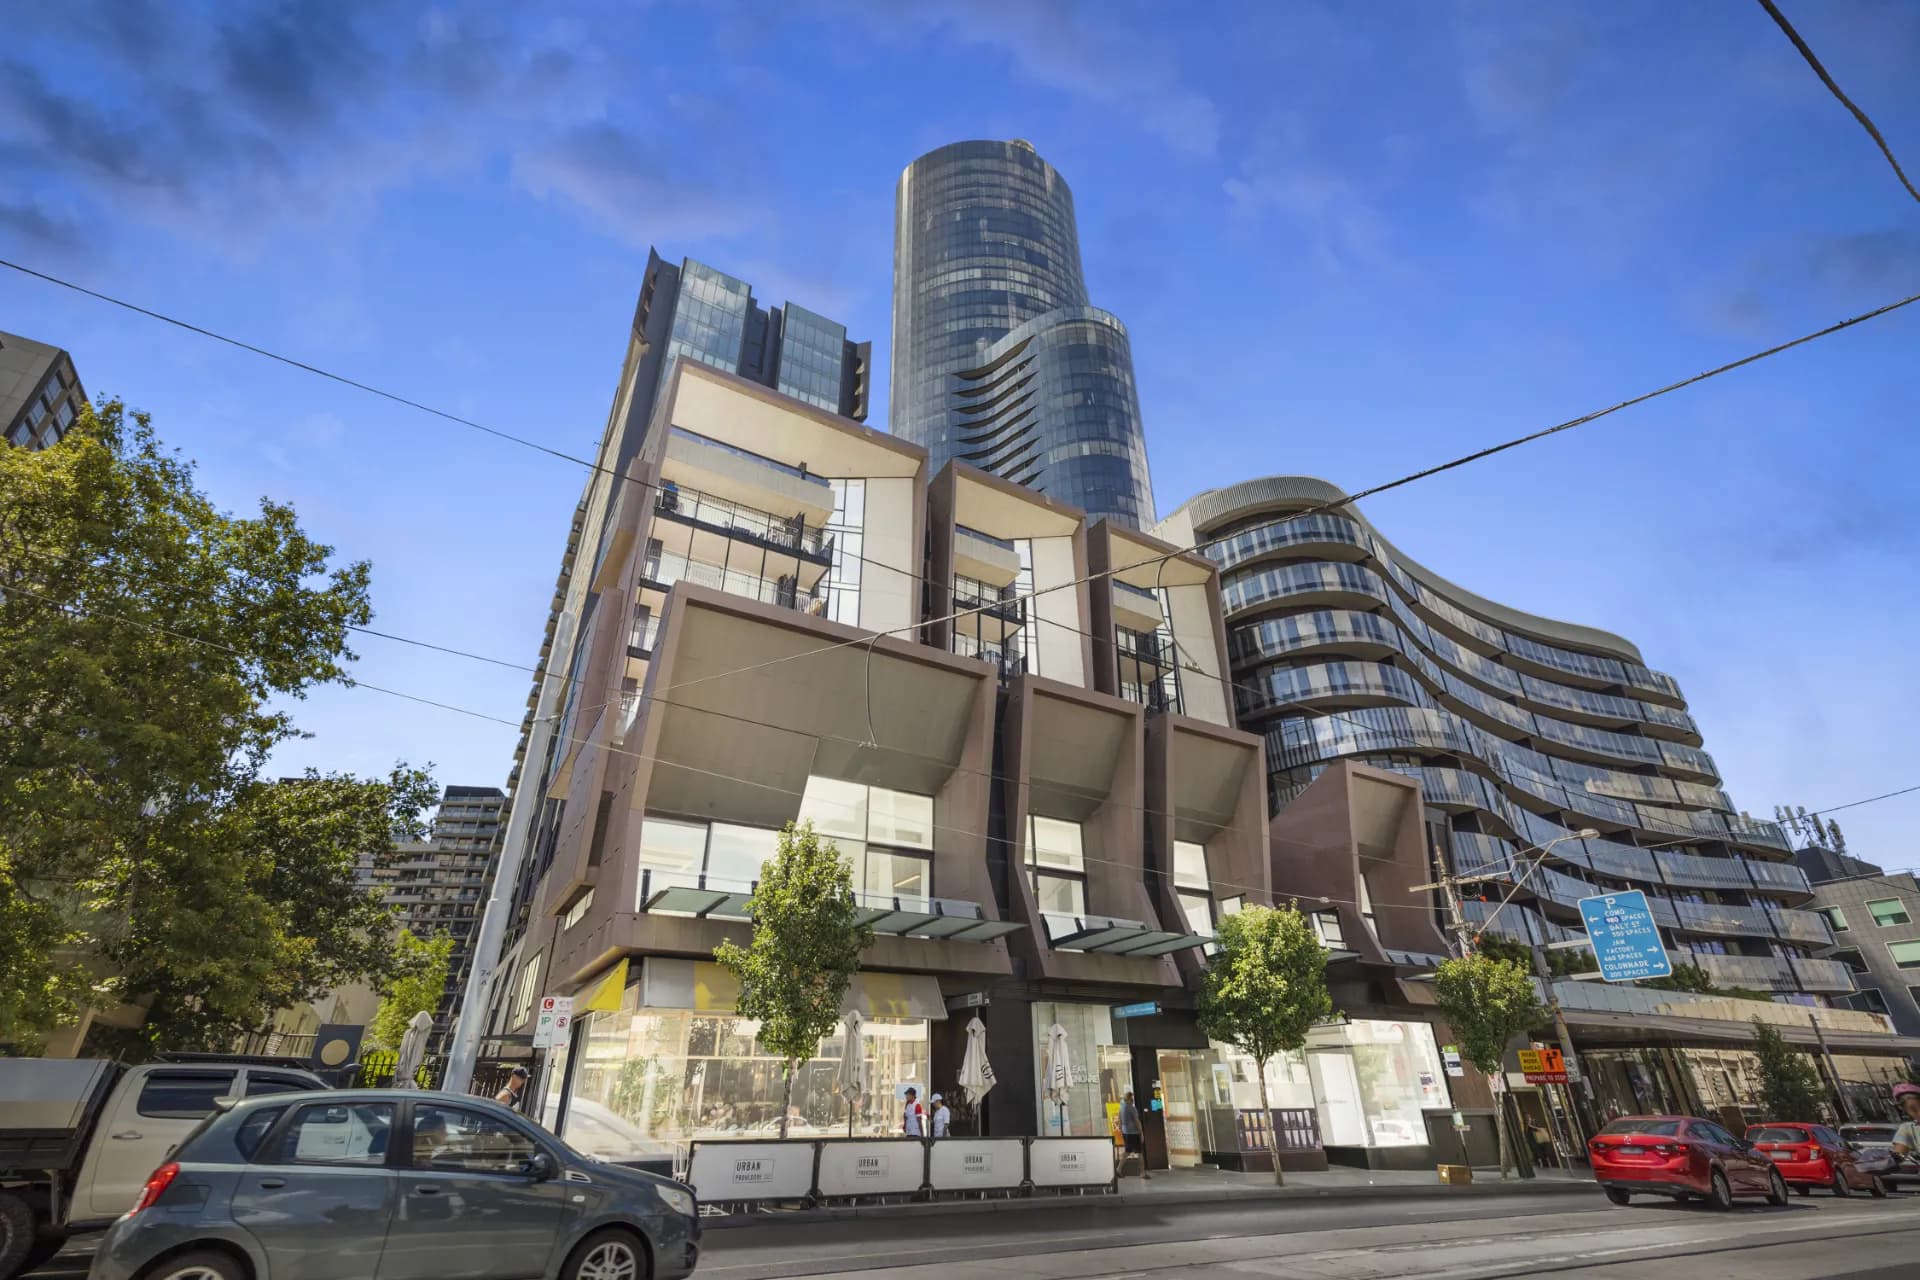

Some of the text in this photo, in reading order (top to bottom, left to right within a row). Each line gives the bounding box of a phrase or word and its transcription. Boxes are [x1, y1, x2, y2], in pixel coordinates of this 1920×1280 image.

[1605, 898, 1616, 909] P
[1605, 909, 1625, 917] COMO
[1621, 913, 1646, 922] SPACES
[1626, 927, 1651, 936] SPACES
[1606, 946, 1634, 954] FACTORY
[1617, 952, 1643, 960] SPACES
[1604, 960, 1649, 971] COLONNADE
[1623, 968, 1649, 977] SPACES
[858, 1158, 879, 1168] URBAN
[964, 1155, 983, 1164] URBAN
[736, 1161, 761, 1171] URBAN
